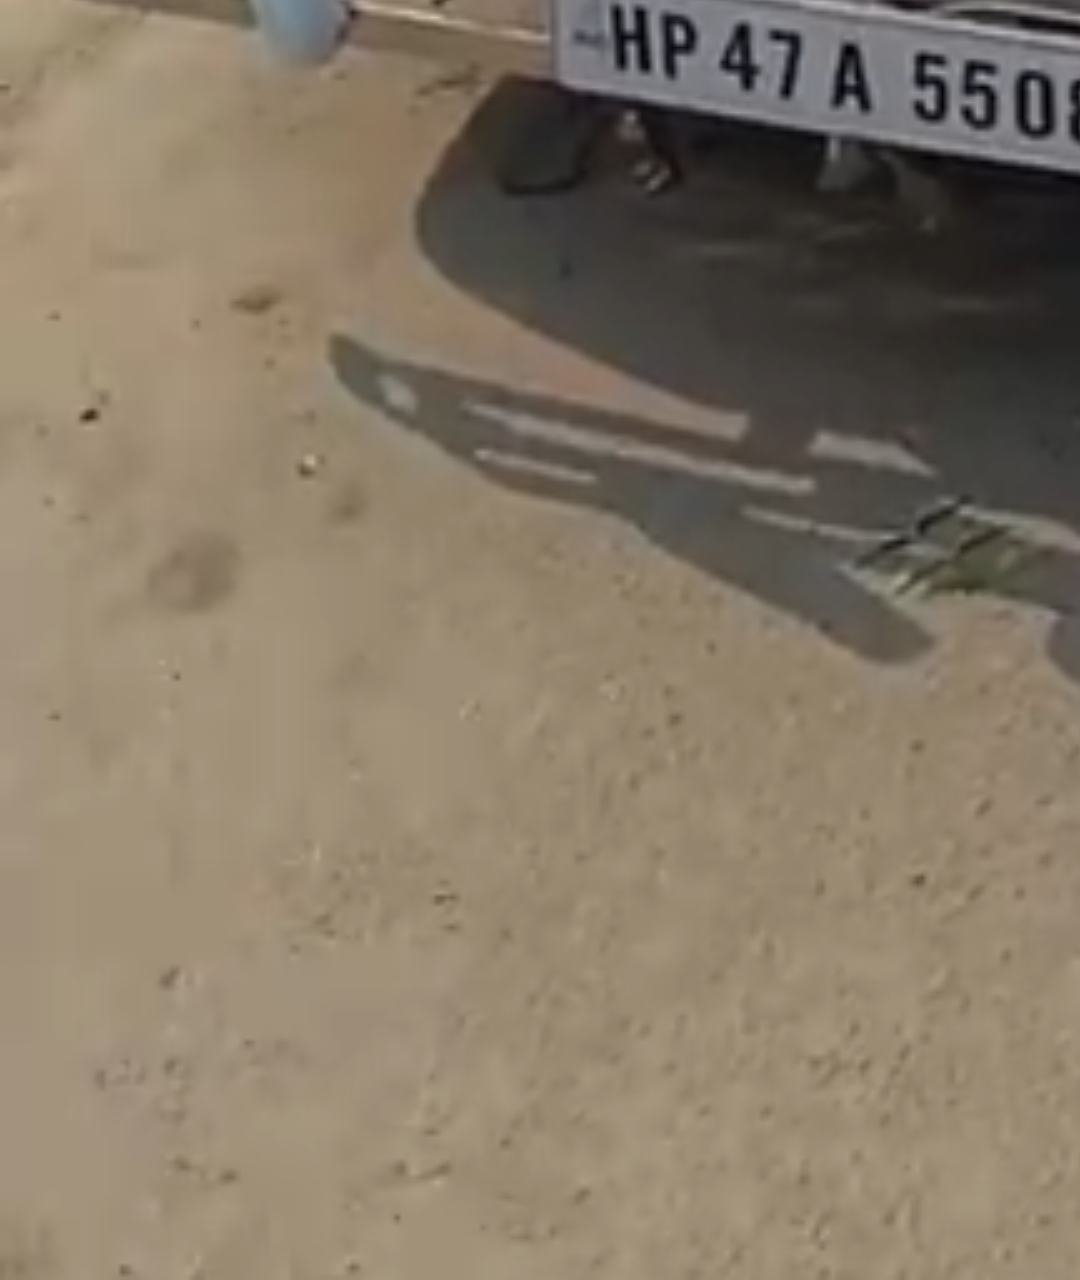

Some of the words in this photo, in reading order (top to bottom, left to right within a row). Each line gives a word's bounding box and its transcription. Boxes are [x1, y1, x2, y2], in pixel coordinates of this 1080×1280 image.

[611, 4, 697, 80] HP
[720, 22, 801, 101] 47
[831, 43, 872, 114] A
